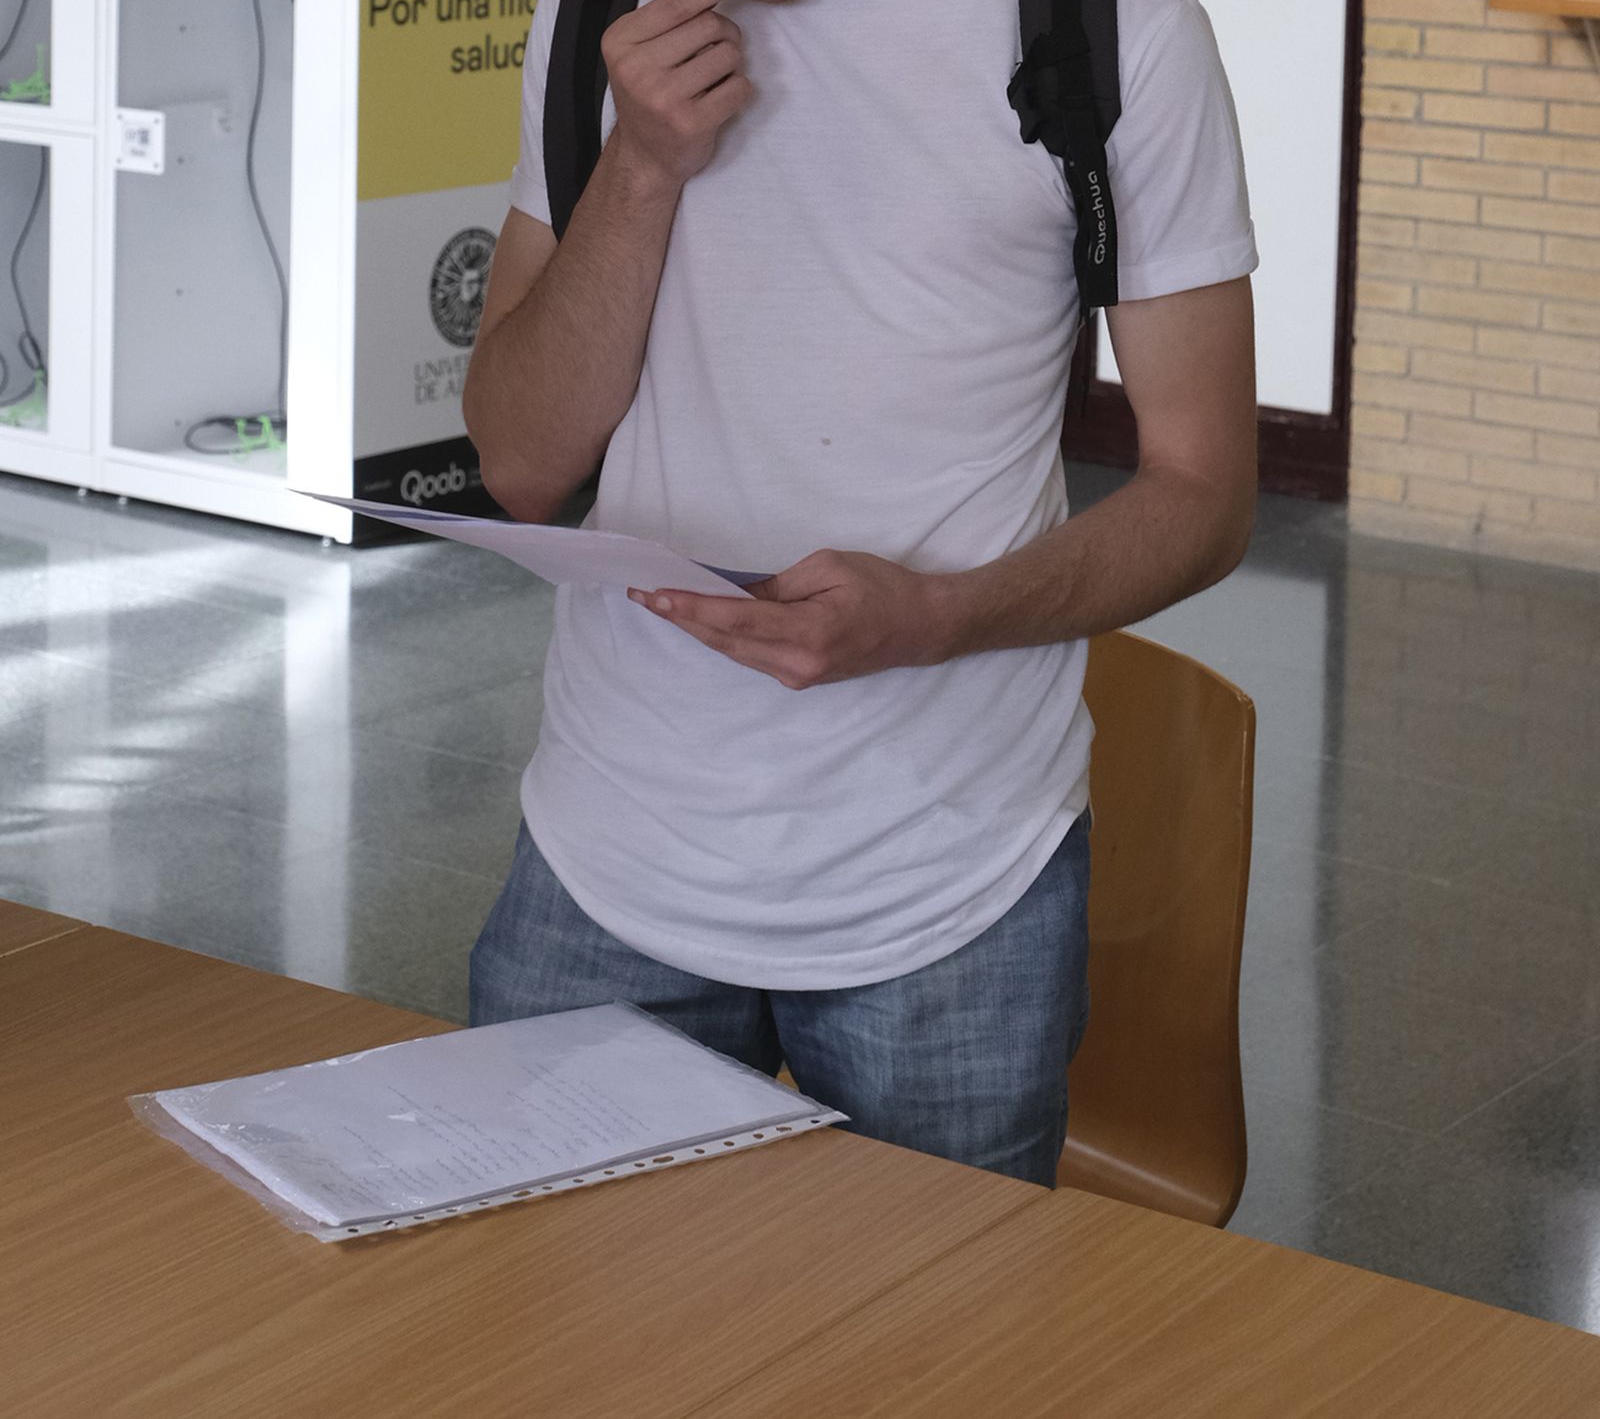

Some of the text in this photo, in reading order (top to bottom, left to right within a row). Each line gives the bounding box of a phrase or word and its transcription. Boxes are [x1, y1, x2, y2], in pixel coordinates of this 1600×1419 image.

[451, 32, 529, 73] salud
[1088, 170, 1106, 264] Quechua
[415, 383, 437, 405] DE
[400, 462, 467, 506] Qoob
